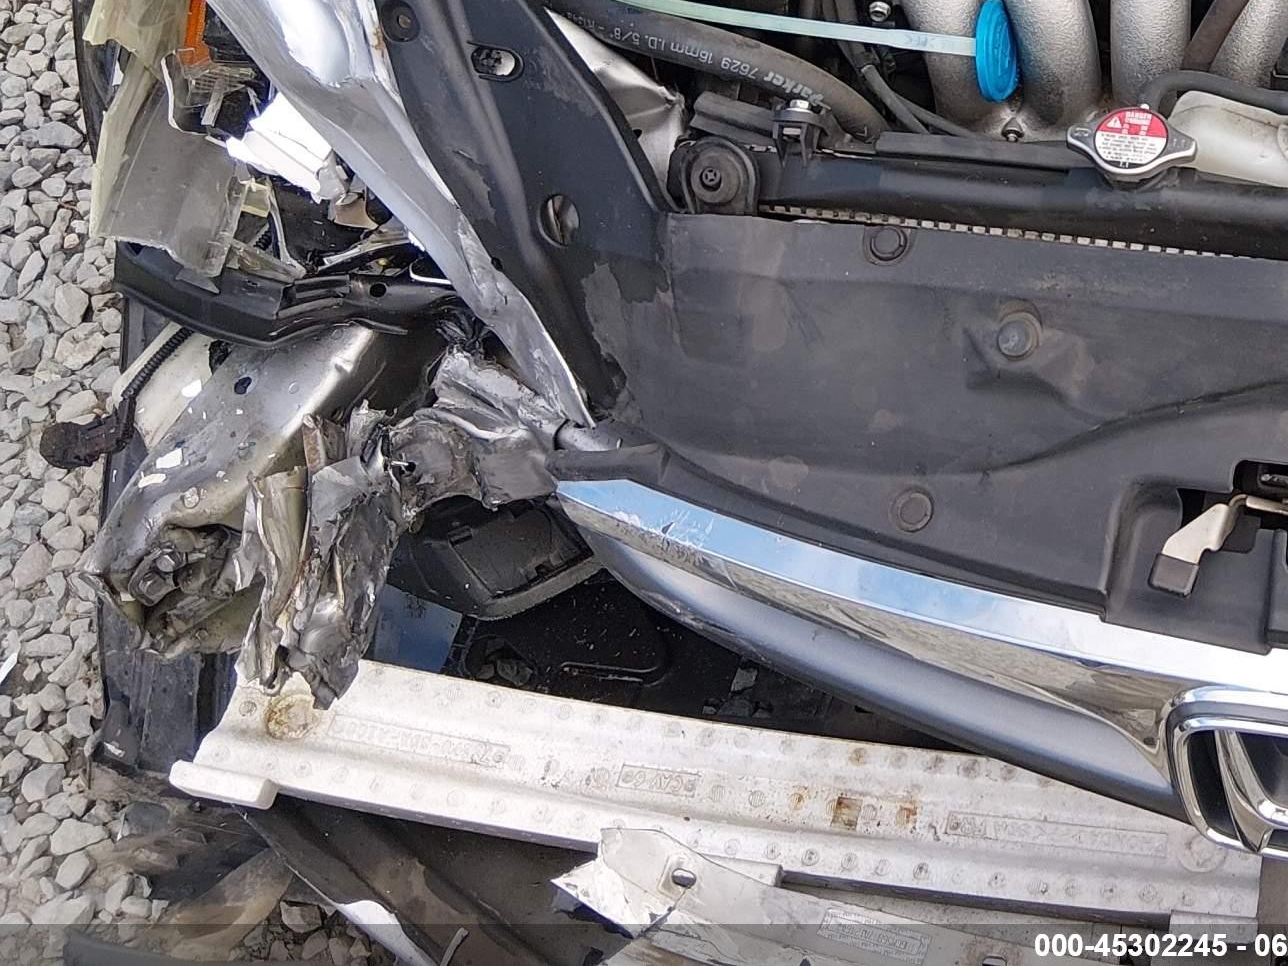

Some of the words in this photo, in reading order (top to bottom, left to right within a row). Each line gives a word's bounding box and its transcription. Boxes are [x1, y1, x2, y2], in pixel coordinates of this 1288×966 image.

[643, 35, 666, 52] I.D.
[669, 42, 713, 65] 16mm
[719, 56, 761, 80] 7629
[766, 71, 825, 106] Parker
